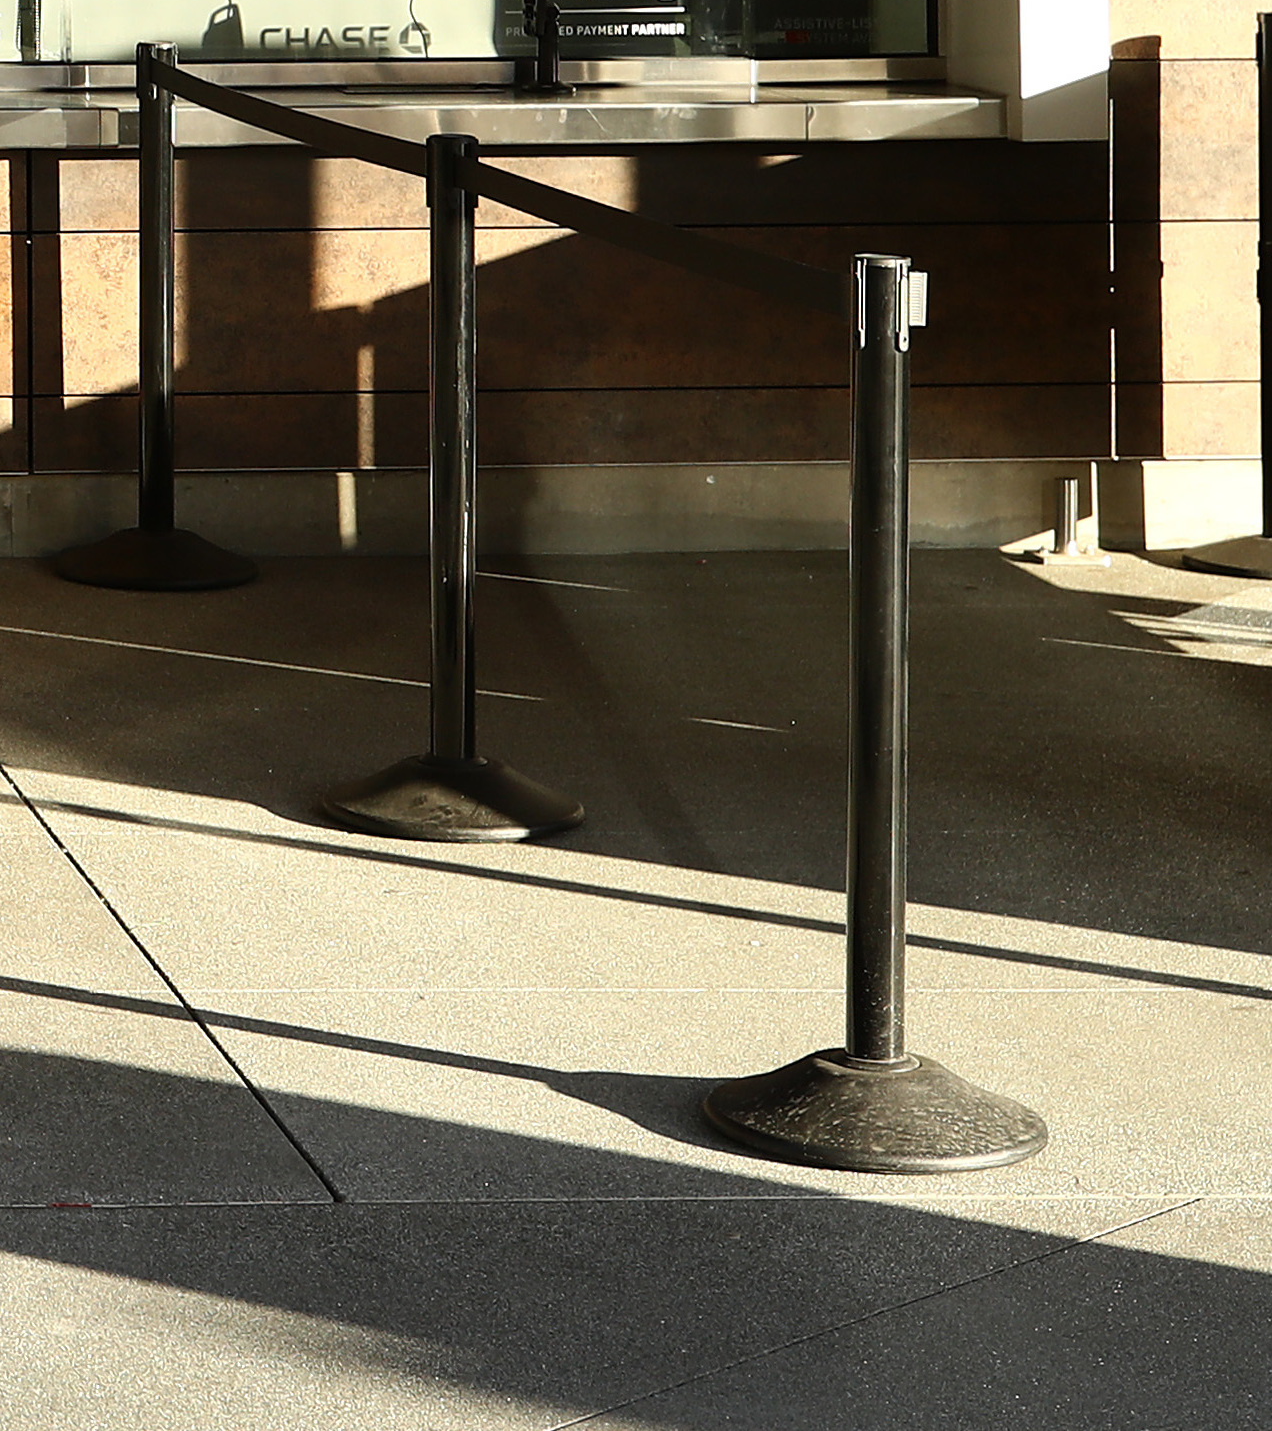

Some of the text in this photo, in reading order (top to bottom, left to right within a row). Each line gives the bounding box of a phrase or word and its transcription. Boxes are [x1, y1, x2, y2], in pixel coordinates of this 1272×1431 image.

[260, 26, 391, 51] CHASE
[576, 25, 629, 36] PAYMENT
[631, 23, 685, 35] PARTNER
